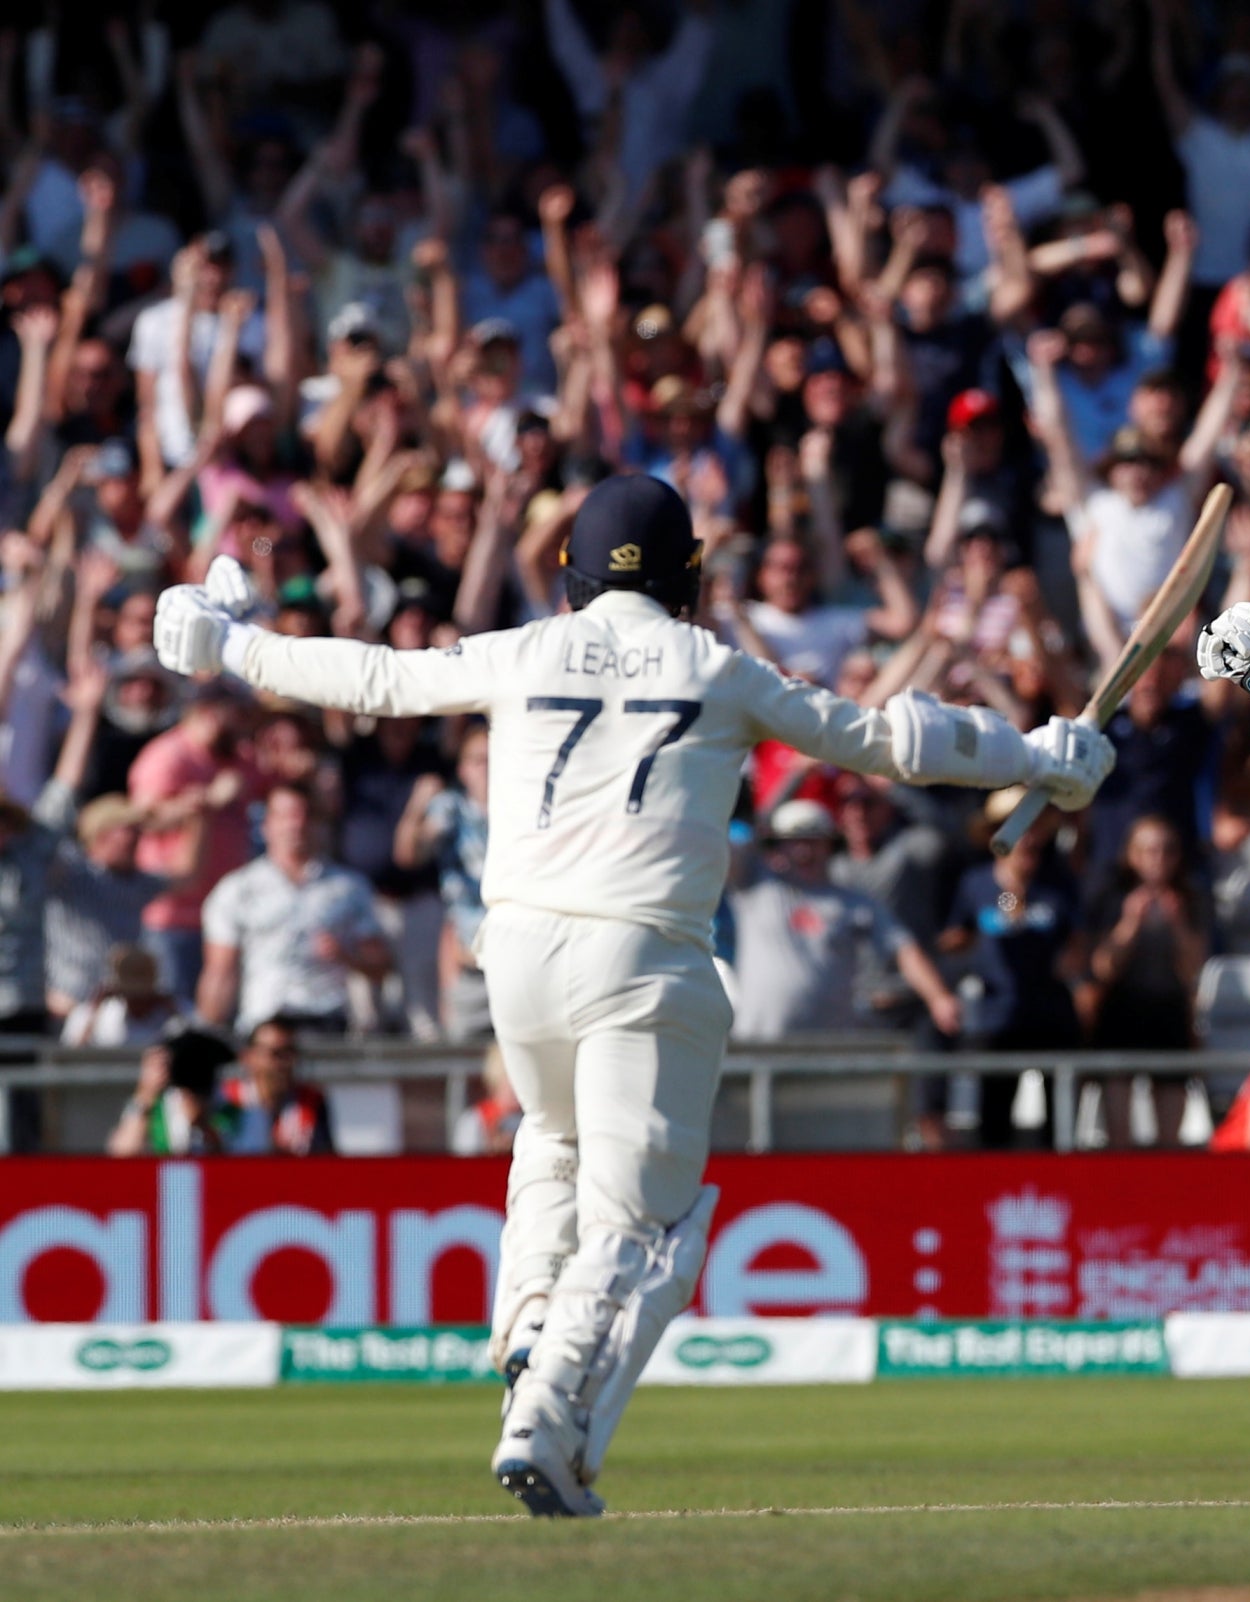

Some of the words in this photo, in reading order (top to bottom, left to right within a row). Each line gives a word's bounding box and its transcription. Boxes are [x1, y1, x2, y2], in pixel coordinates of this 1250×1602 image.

[564, 642, 664, 679] LEACH
[526, 696, 703, 829] 77
[0, 1161, 868, 1323] alane
